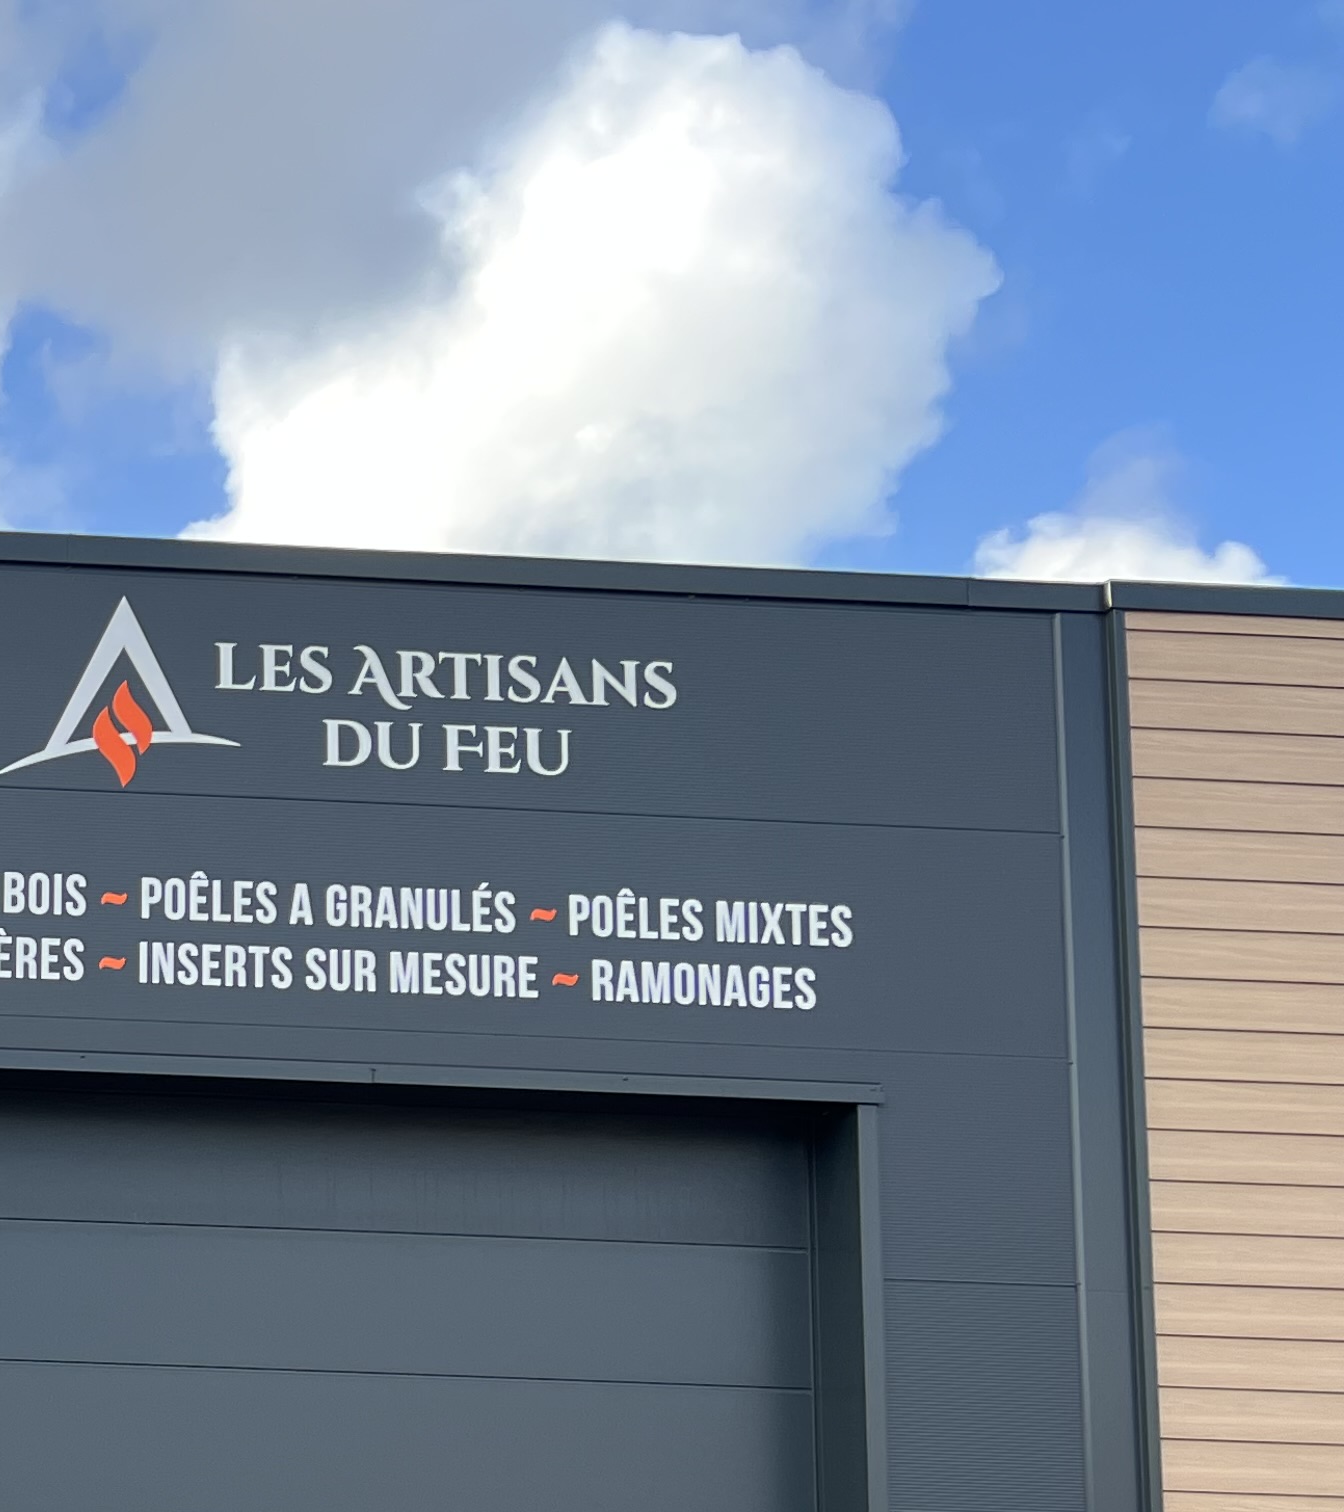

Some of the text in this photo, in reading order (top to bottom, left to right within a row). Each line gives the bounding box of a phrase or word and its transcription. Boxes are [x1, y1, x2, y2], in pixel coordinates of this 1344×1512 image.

[215, 643, 676, 710] LES ARTISANS
[323, 719, 571, 775] DU FEU
[4, 872, 86, 916] BOIS
[142, 871, 276, 923] POÊLES
[290, 883, 313, 925] A
[327, 883, 515, 933] GRANULÉS
[569, 888, 703, 941] POÊLES
[716, 901, 852, 947] MIXTES
[140, 942, 292, 988] INSERTS
[306, 948, 378, 992] SUR
[390, 950, 538, 998] MESURE
[592, 959, 816, 1009] RAMONAGES
